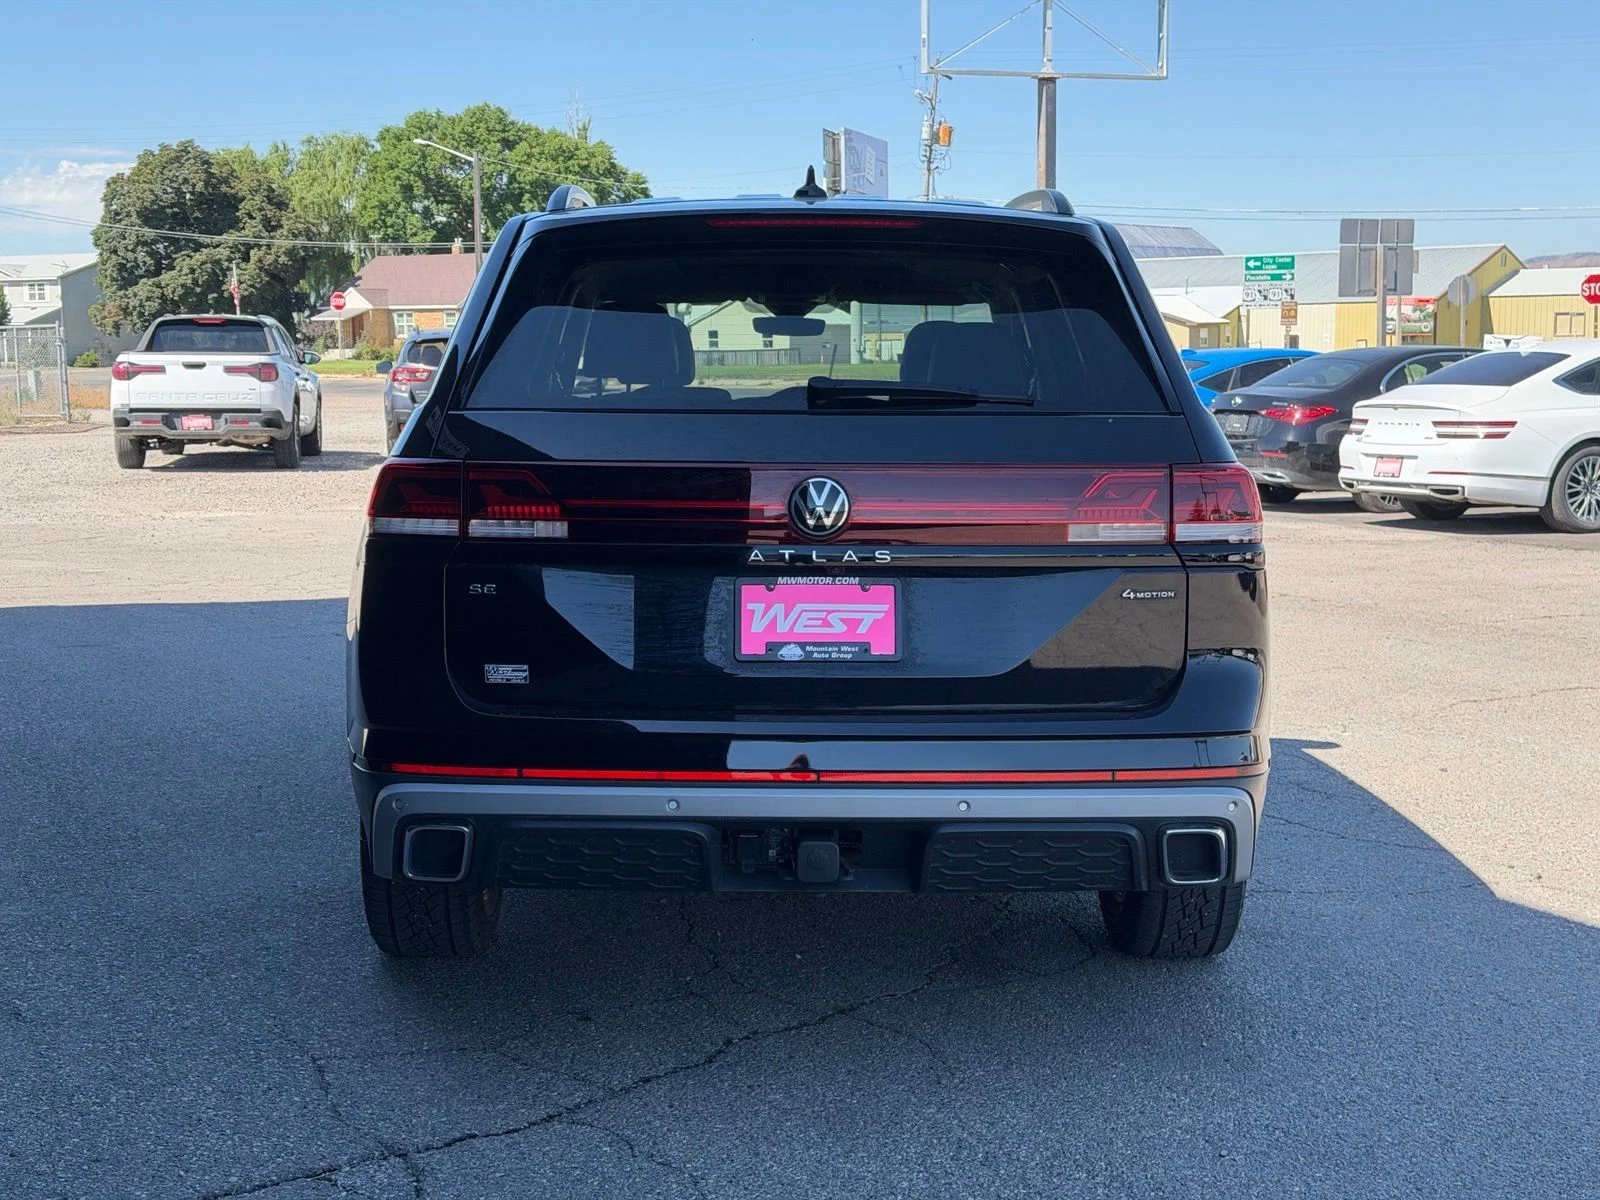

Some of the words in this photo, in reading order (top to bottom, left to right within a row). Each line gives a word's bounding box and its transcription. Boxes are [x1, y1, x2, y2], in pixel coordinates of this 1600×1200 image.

[1582, 283, 1600, 296] STO
[332, 297, 345, 306] STOP
[135, 392, 197, 401] SANTA
[202, 392, 254, 401] CRUZ
[748, 549, 891, 563] ATLAS
[777, 576, 860, 586] MWMOTOR.COM
[469, 583, 497, 595] SE
[747, 603, 890, 634] WEST
[831, 652, 853, 660] Group
